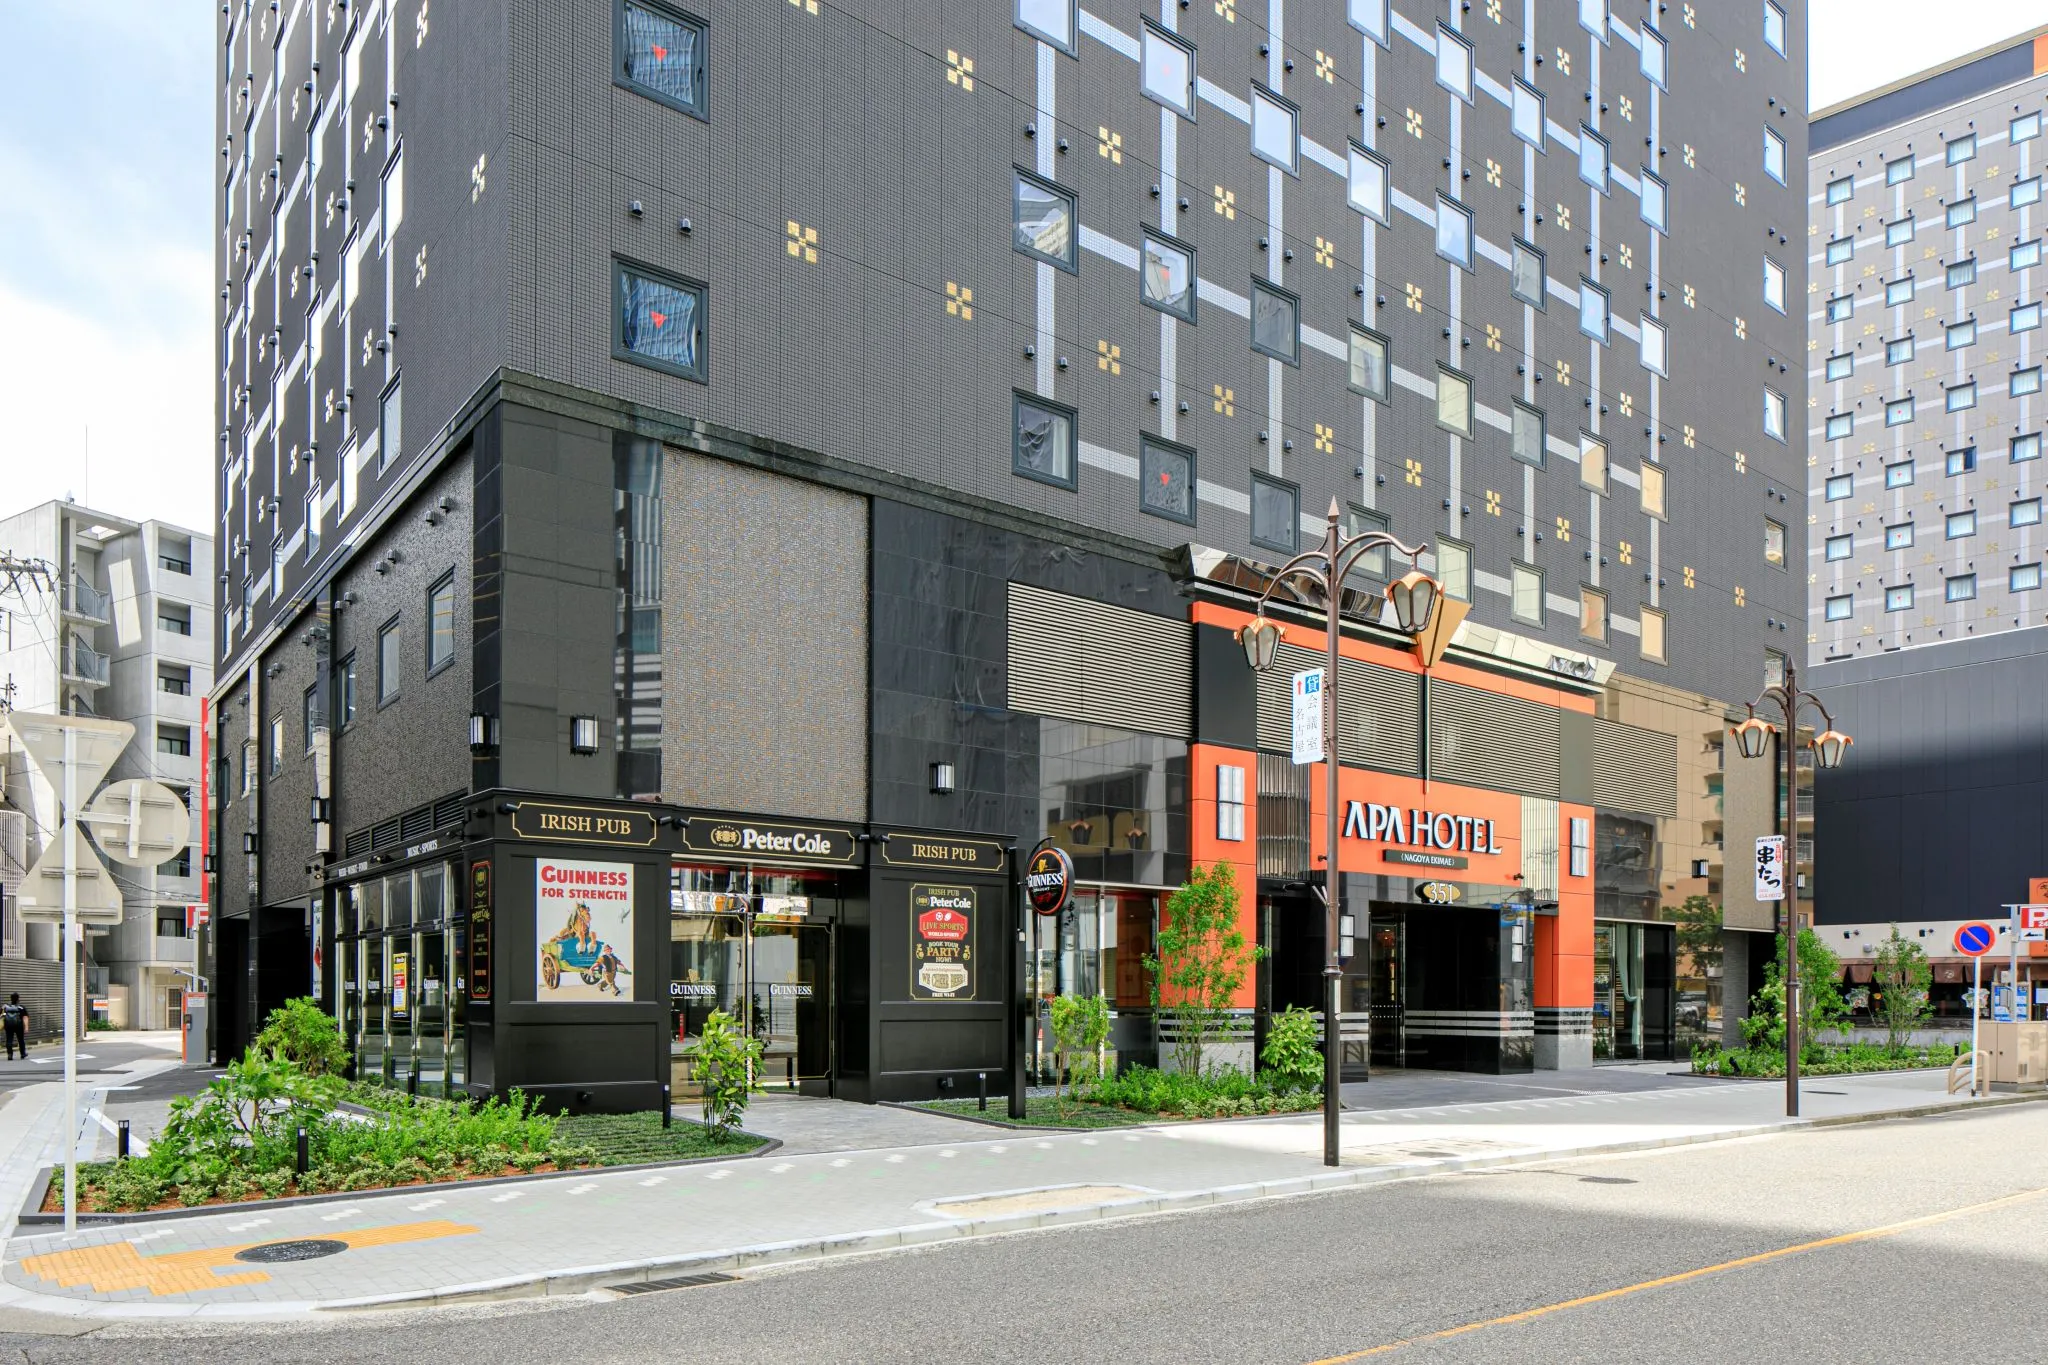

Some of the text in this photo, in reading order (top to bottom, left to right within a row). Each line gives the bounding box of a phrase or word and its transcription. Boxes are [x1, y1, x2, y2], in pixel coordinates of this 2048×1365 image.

[540, 813, 631, 835] IRISH PUB
[1343, 800, 1502, 855] APA HOTEL
[742, 828, 831, 854] Peter Cole
[912, 844, 977, 862] IRISH PUB
[541, 865, 627, 886] GUINNESS
[1757, 846, 1781, 888] 串たつ
[542, 888, 627, 900] FOR STRENGTH
[1429, 882, 1454, 904] 351
[930, 896, 972, 909] Peter Cole
[922, 922, 965, 932] LIVE SPORTS
[927, 947, 960, 957] PARTY
[670, 982, 717, 995] GUINNESS
[769, 983, 813, 995] GUINNESS
